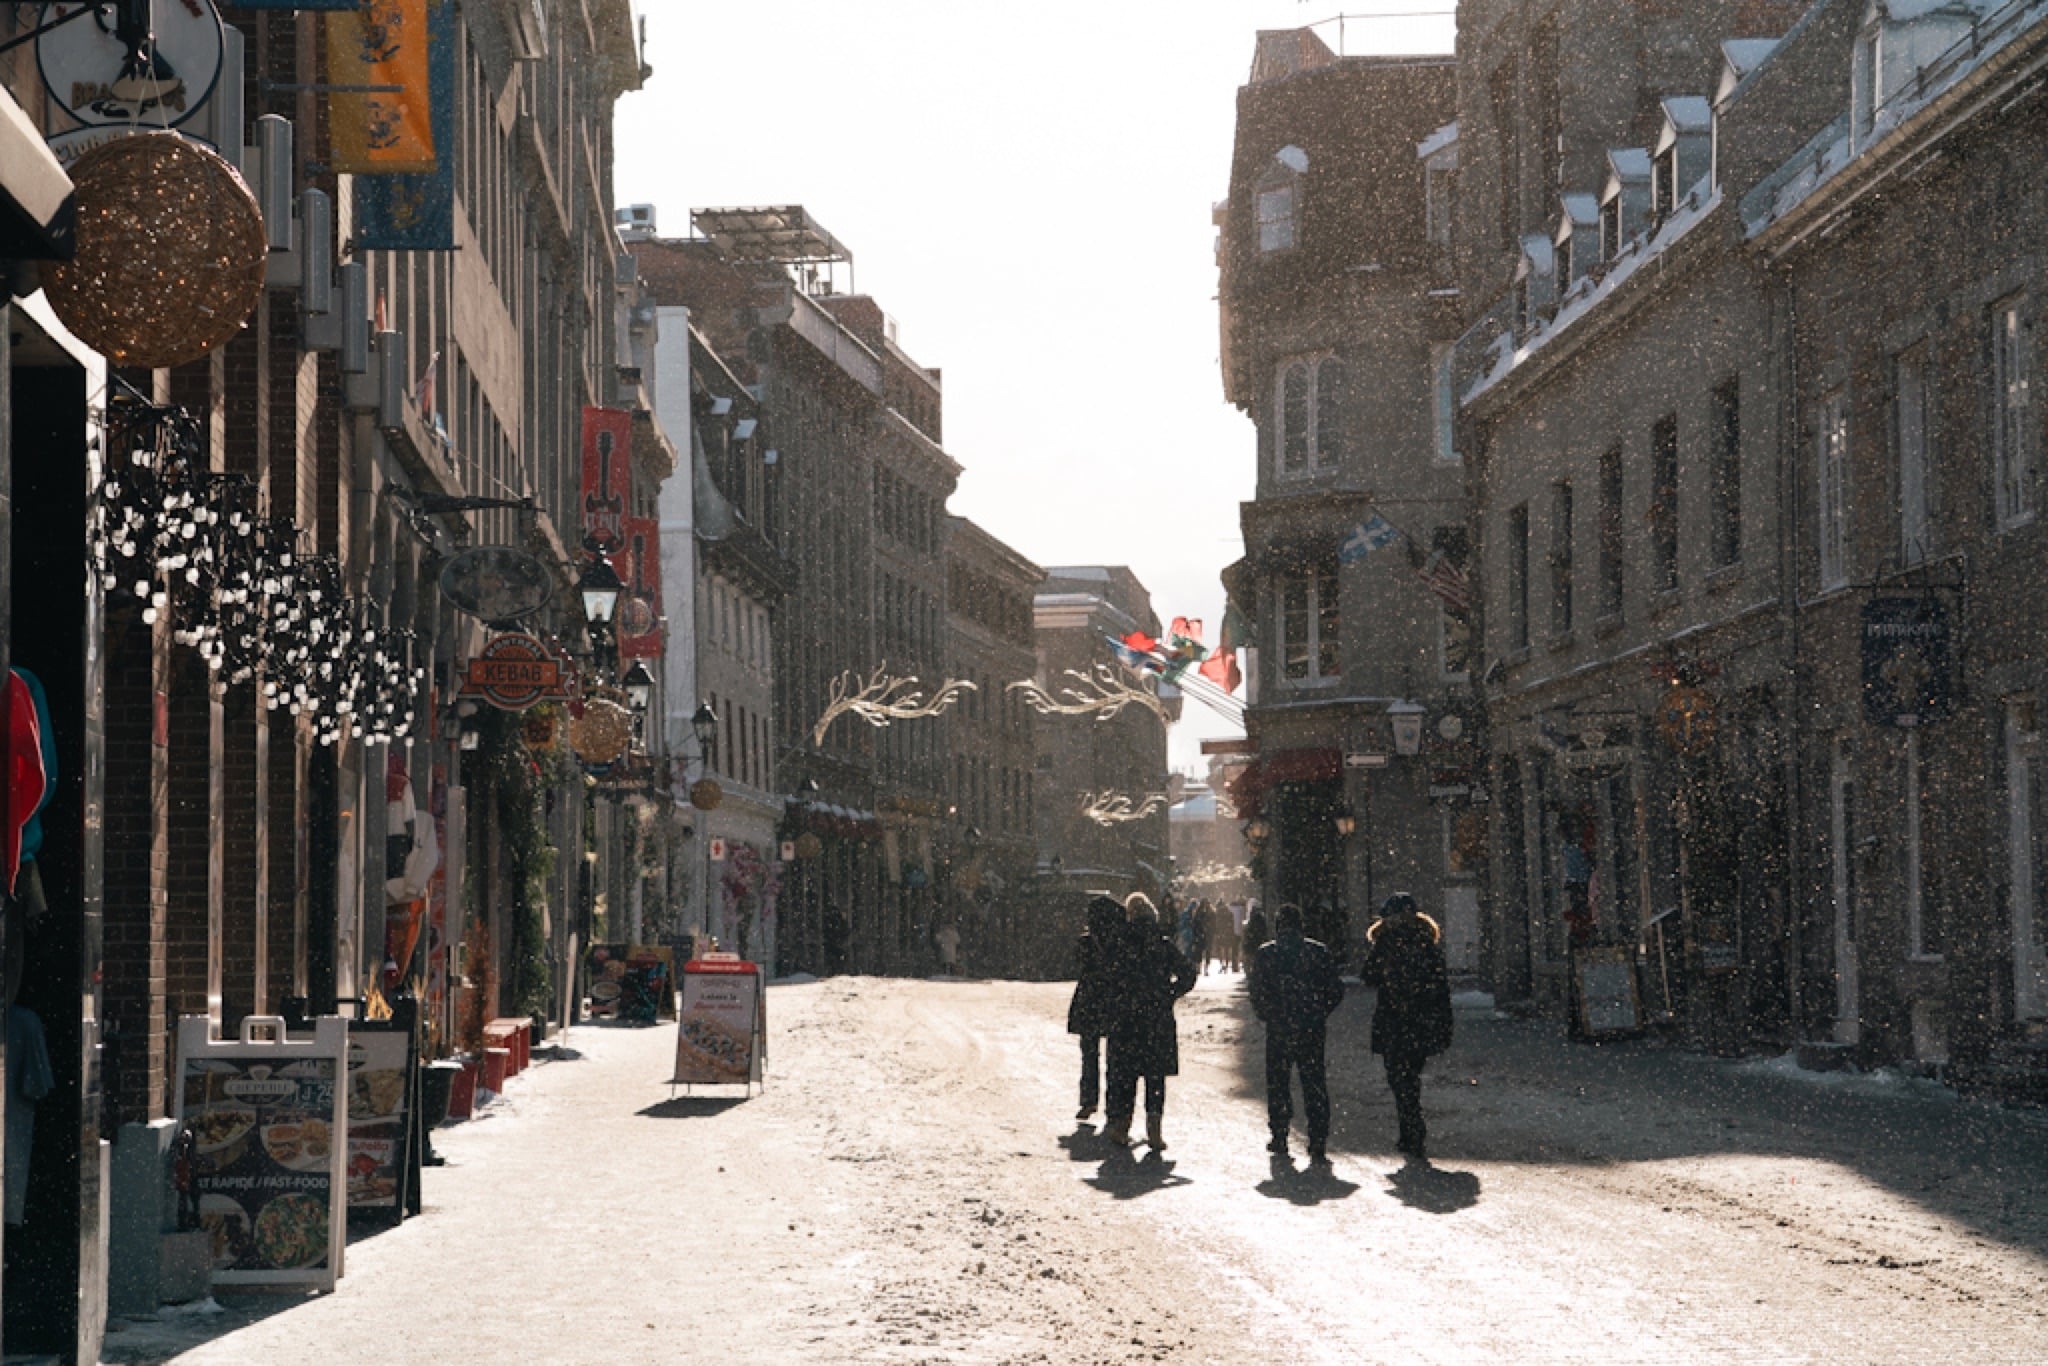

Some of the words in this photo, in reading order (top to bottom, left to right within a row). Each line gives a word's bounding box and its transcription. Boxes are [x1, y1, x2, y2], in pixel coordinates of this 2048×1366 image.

[485, 663, 542, 681] KEBAB
[212, 1176, 255, 1188] RAPIDE
[263, 1176, 328, 1188] FAST-FOOD
